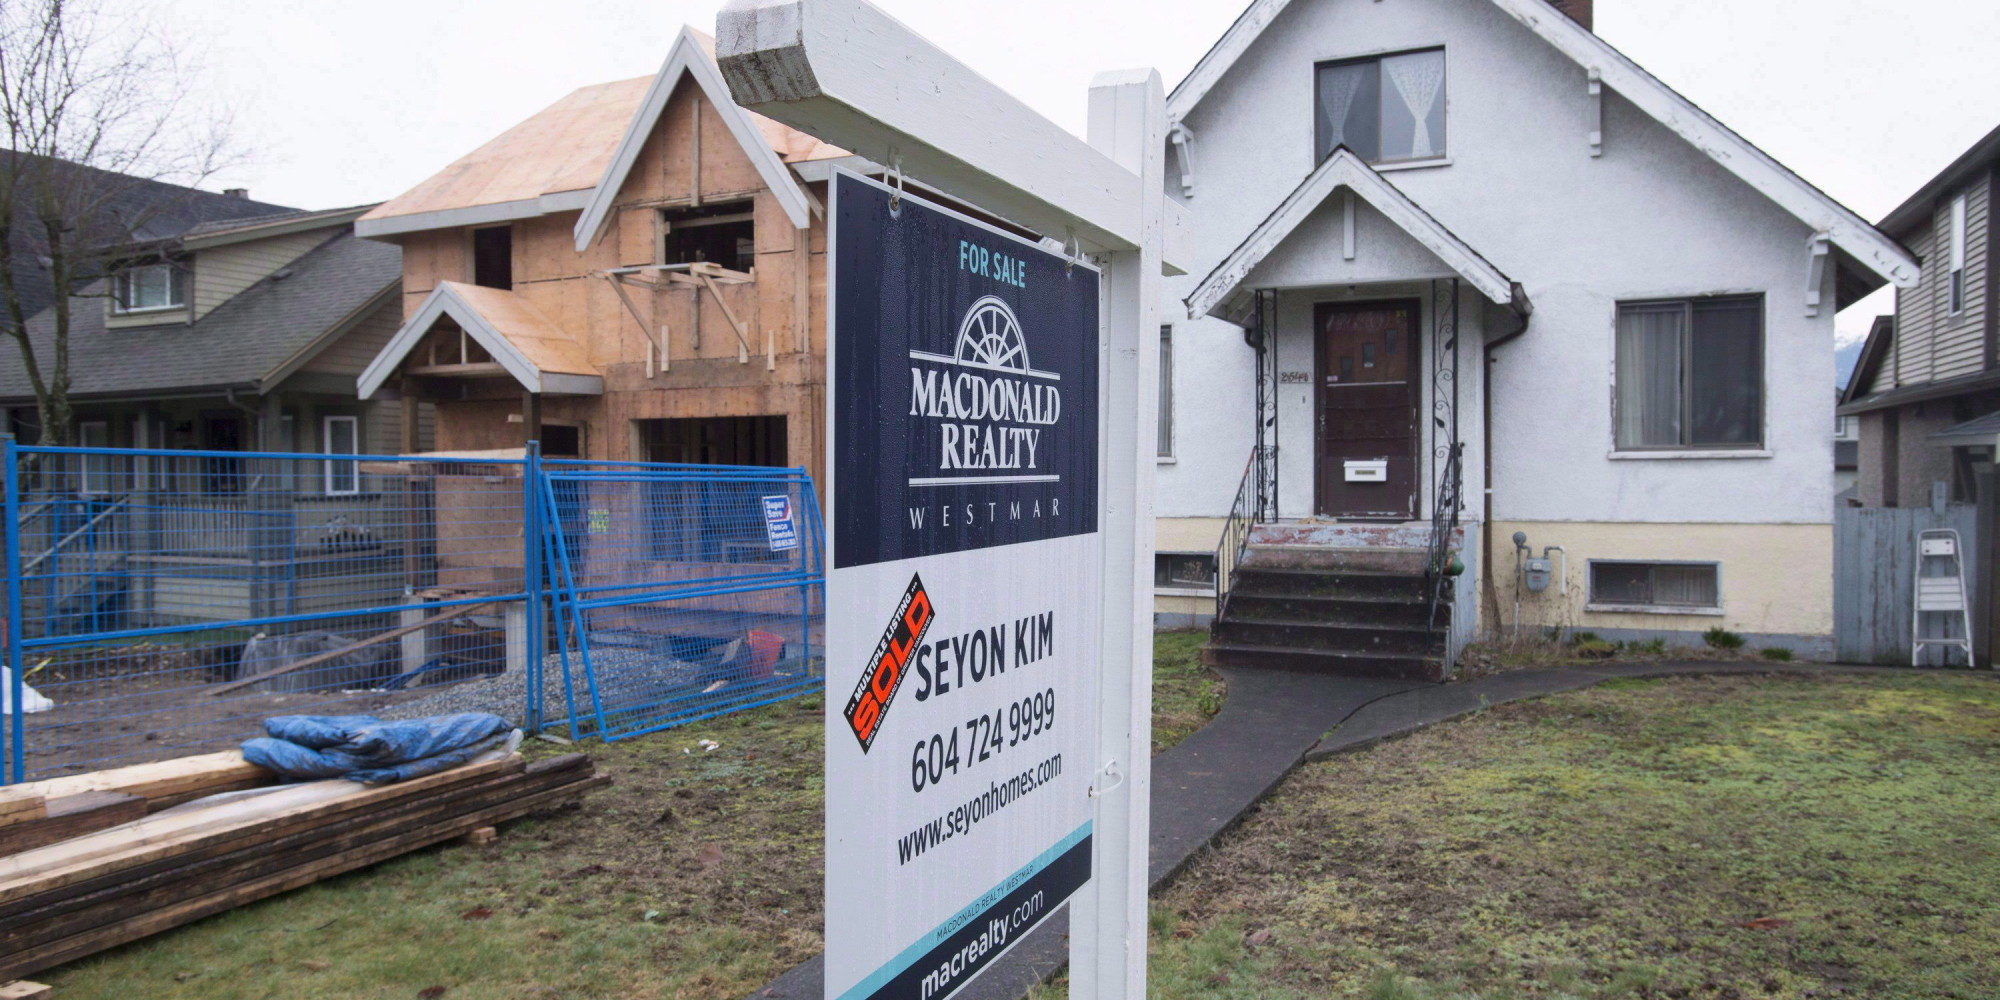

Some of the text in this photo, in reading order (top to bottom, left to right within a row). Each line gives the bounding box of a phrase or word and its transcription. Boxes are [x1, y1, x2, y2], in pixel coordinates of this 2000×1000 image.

[960, 240, 1026, 288] FOR SALE
[910, 367, 1061, 425] MACDONALD
[940, 423, 1040, 469] REALTY
[910, 498, 1059, 530] WESTMAR
[853, 590, 930, 741] SOLD
[854, 592, 912, 703] MULTIPLE LISTING
[874, 704, 887, 730] ESTATE
[885, 682, 898, 706] BOARD
[896, 673, 902, 684] OF
[900, 646, 916, 675] GREATER
[915, 610, 1053, 702] SEYON KIM
[911, 687, 1055, 793] 604 724 9999
[898, 752, 1062, 866] www.seyonhomes.com
[921, 890, 1044, 1000] macrealty.com
[936, 865, 1034, 941] MACDONALD REALTY WESTMAR
